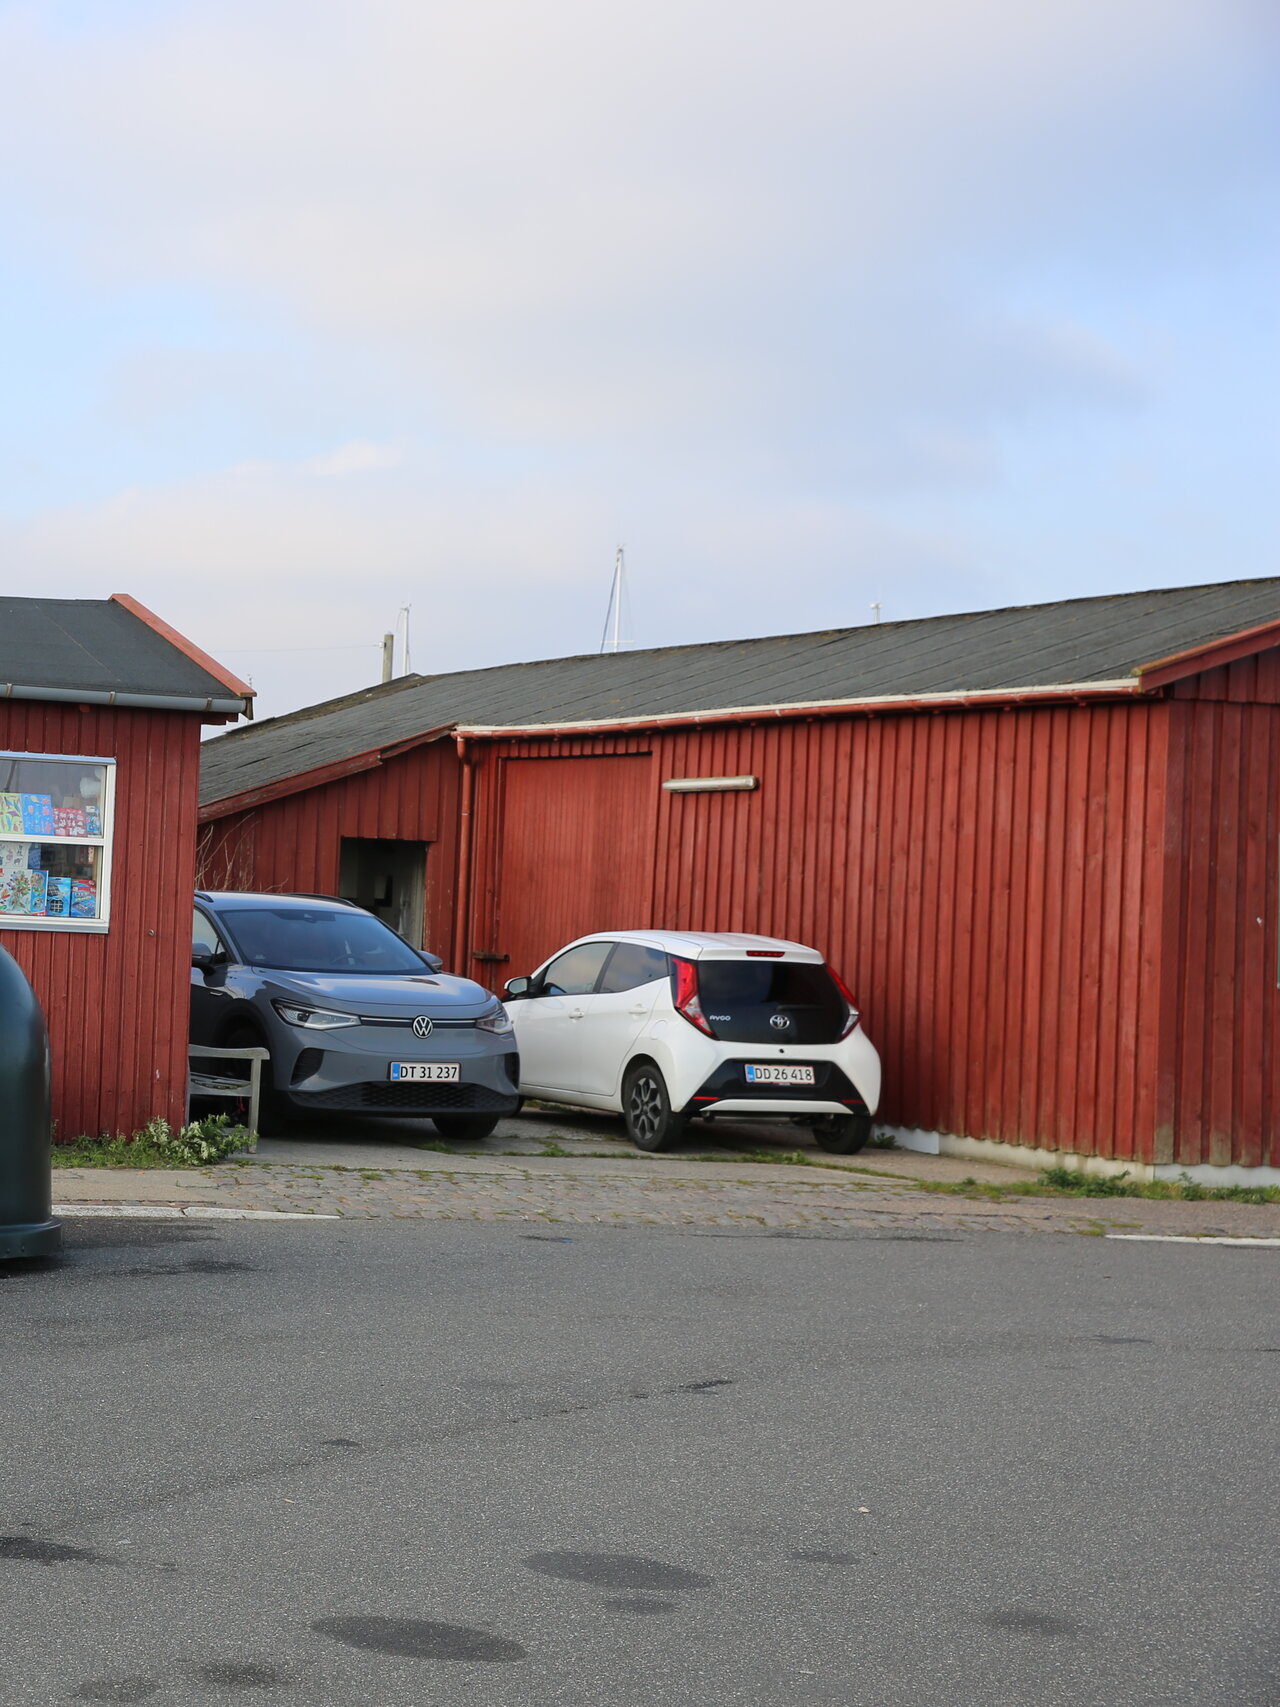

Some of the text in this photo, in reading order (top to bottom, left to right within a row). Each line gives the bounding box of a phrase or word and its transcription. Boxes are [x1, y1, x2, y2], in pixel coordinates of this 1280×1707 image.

[400, 1066, 458, 1079] DT 31 237
[755, 1068, 812, 1081] DD 26 418
